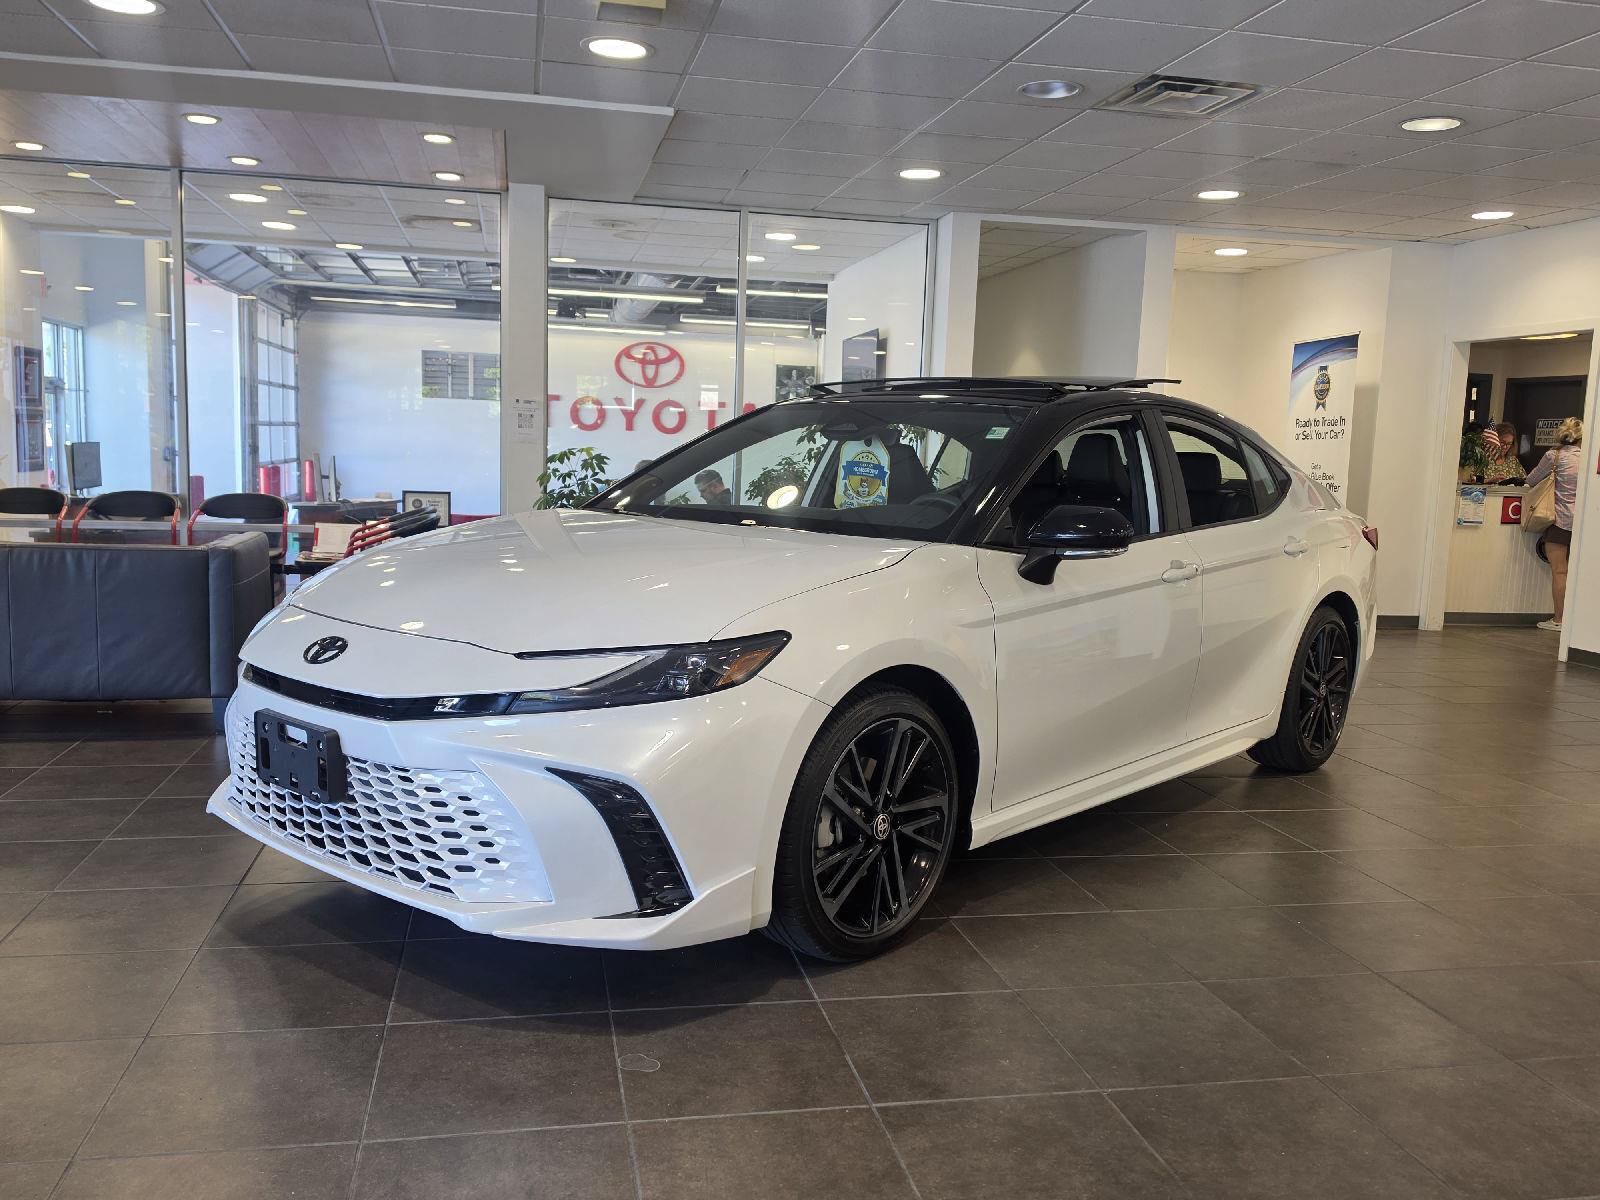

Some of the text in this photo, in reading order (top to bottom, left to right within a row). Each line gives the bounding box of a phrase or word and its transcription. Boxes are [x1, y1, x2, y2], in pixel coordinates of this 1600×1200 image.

[1295, 416, 1346, 429] Ready to Trade In
[1302, 430, 1313, 440] Sell
[1314, 430, 1328, 440] Your
[1329, 429, 1345, 440] Car?
[1322, 472, 1335, 481] Book
